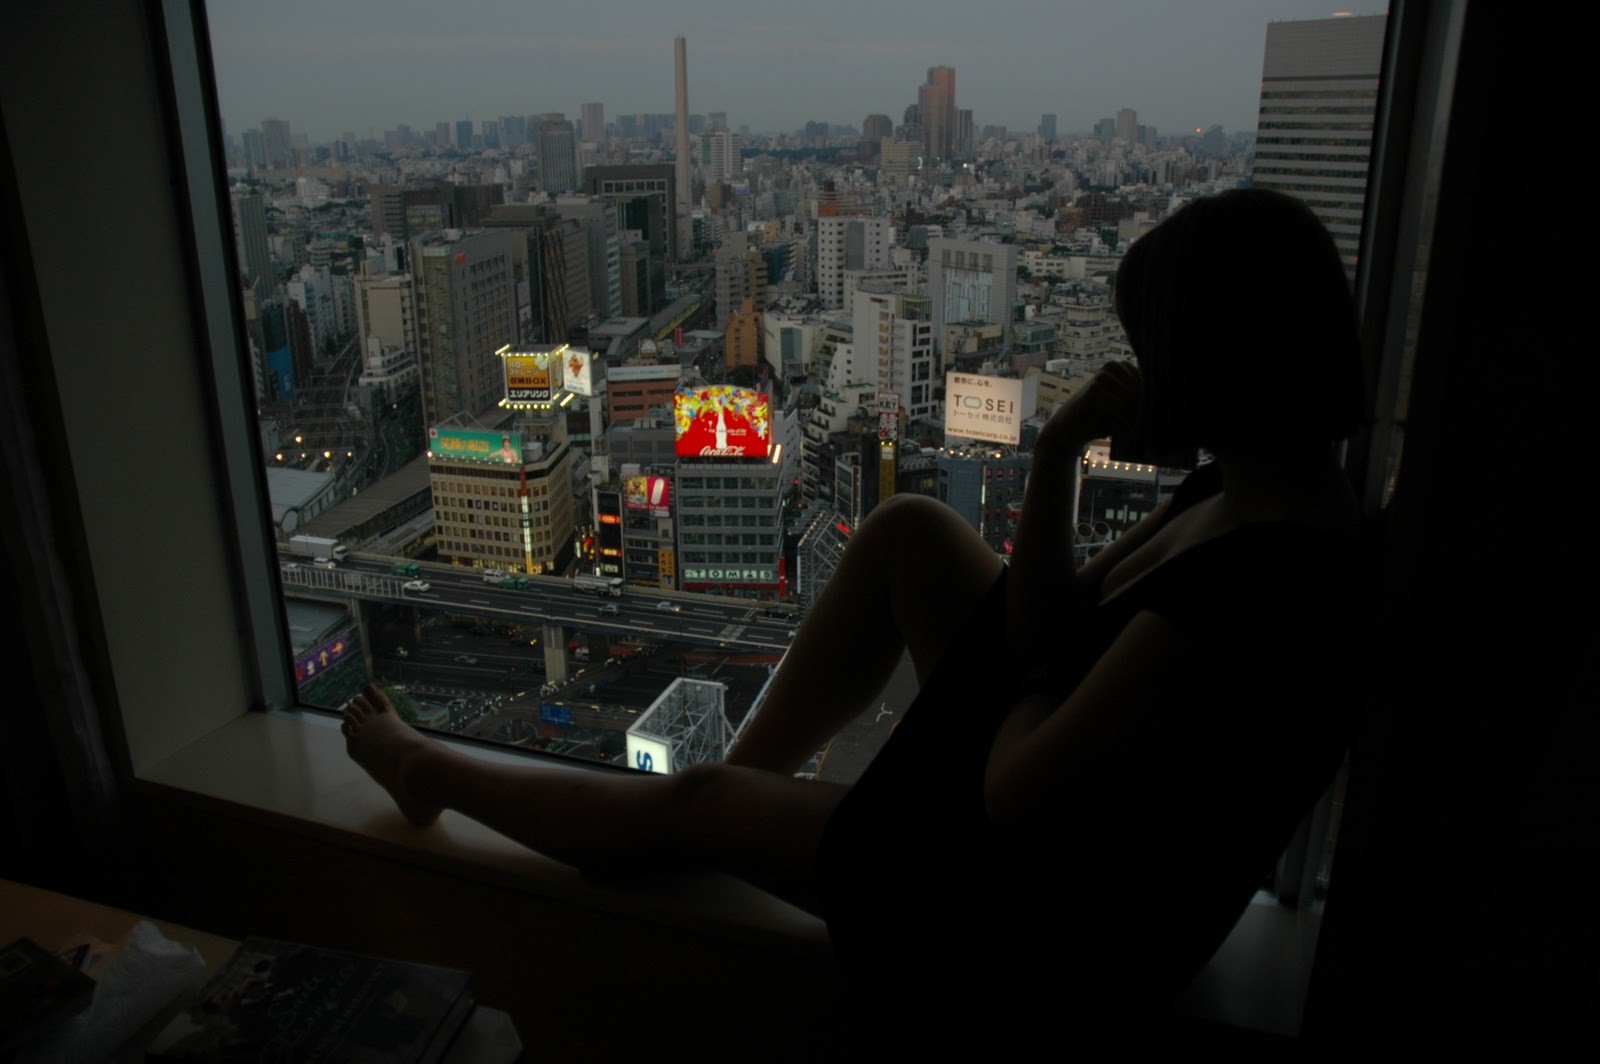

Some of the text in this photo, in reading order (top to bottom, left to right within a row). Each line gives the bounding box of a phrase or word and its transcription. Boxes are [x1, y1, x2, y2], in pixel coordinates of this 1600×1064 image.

[510, 390, 549, 398] エリアリング
[880, 401, 897, 409] KEY
[953, 393, 1014, 414] TOSEI
[947, 427, 1017, 441] www.toseicorp.co.jp
[695, 569, 770, 579] TOMAS
